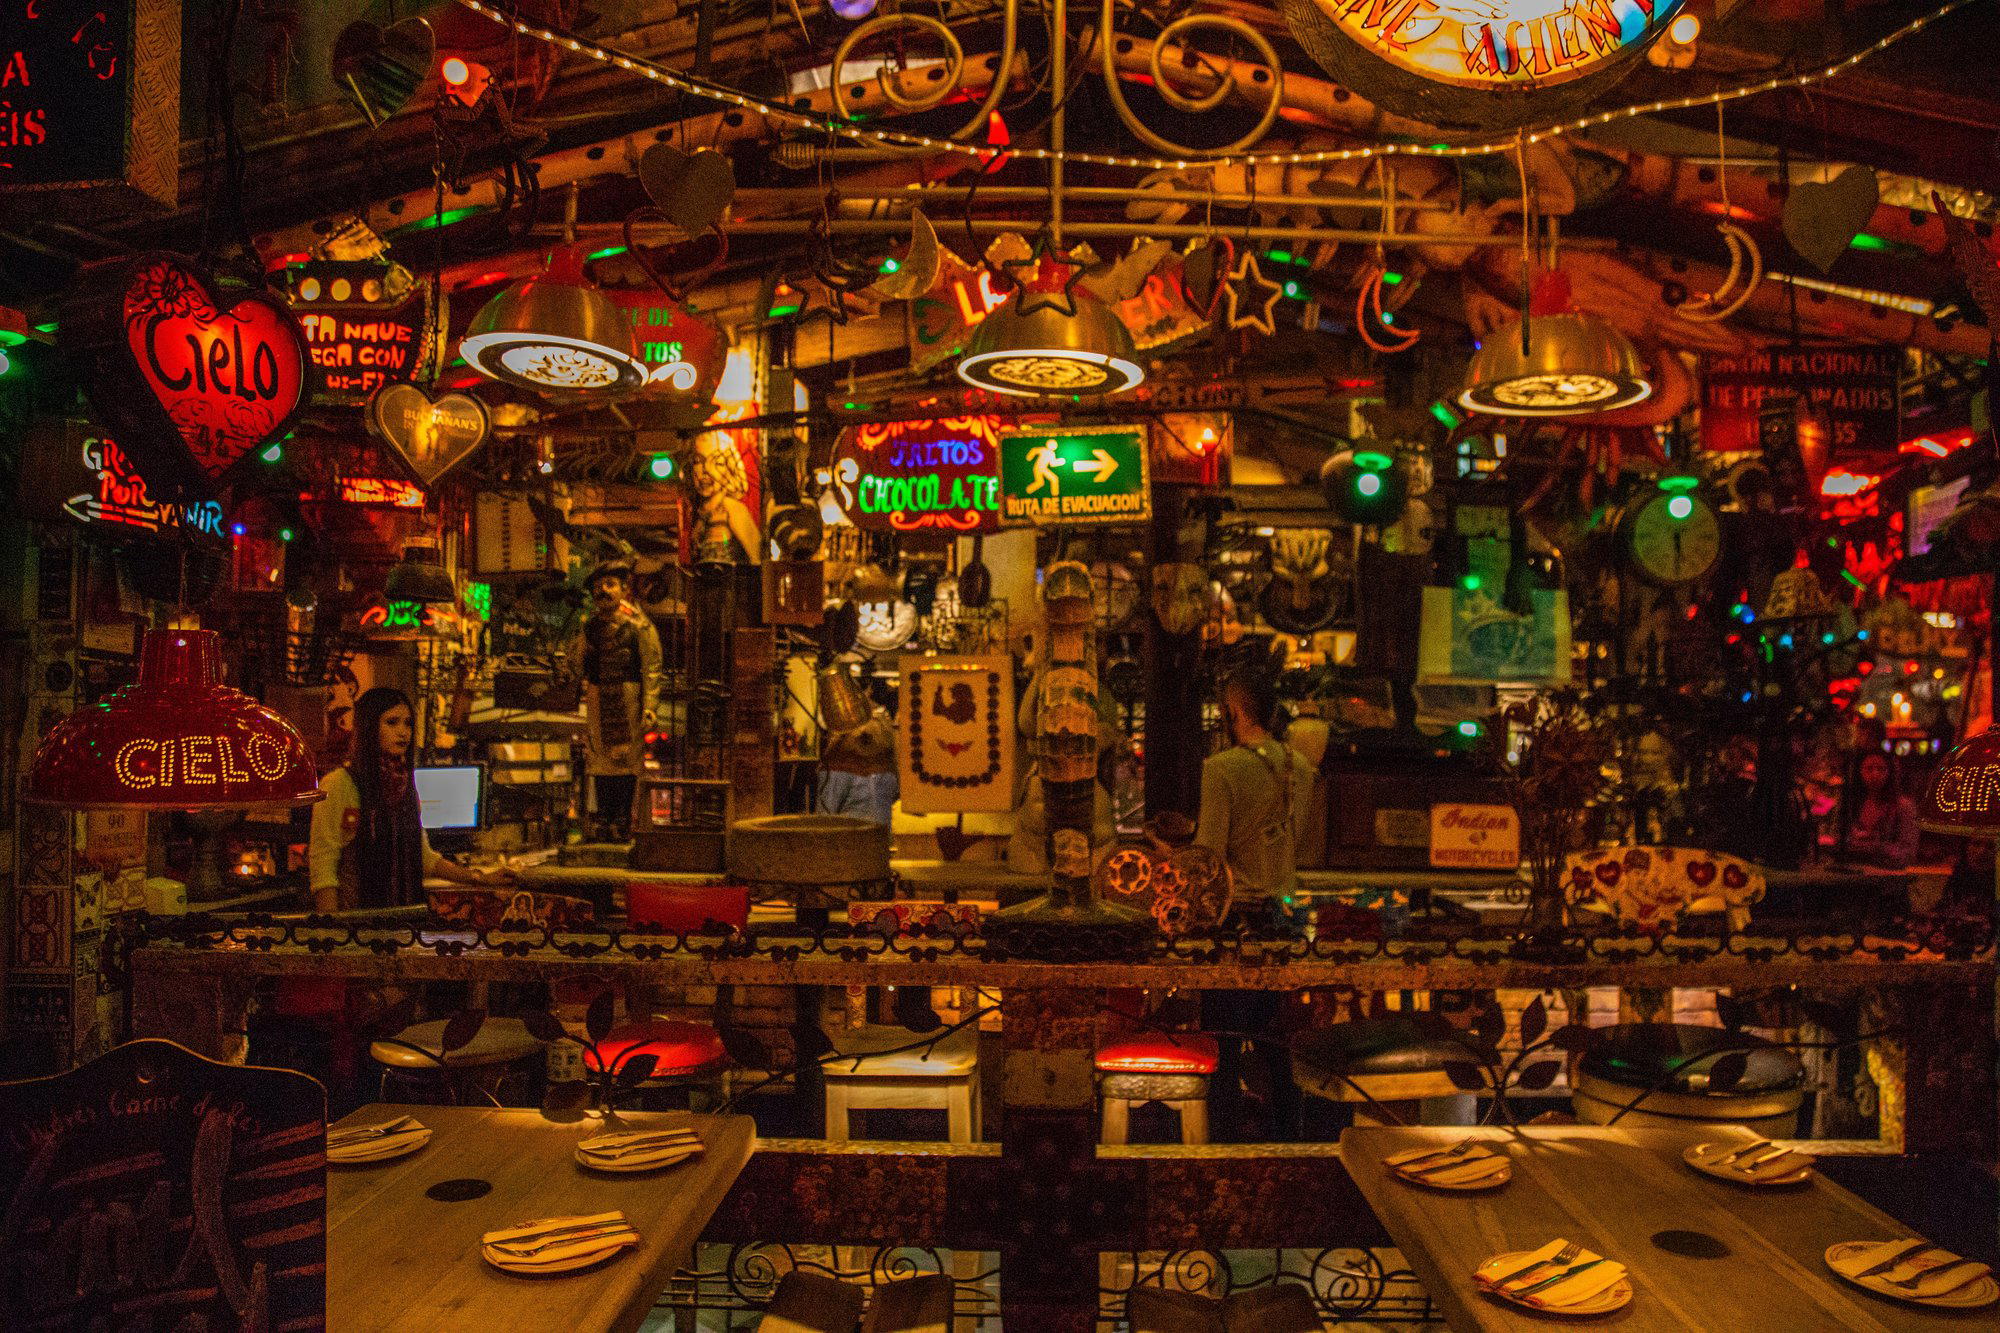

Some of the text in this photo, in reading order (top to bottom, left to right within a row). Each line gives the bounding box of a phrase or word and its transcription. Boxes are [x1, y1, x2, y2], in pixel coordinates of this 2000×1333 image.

[358, 344, 406, 370] CON
[859, 473, 1000, 513] CHOCOLATE
[1006, 498, 1041, 517] RUTA
[1042, 496, 1060, 515] DE
[115, 734, 288, 790] CIELO
